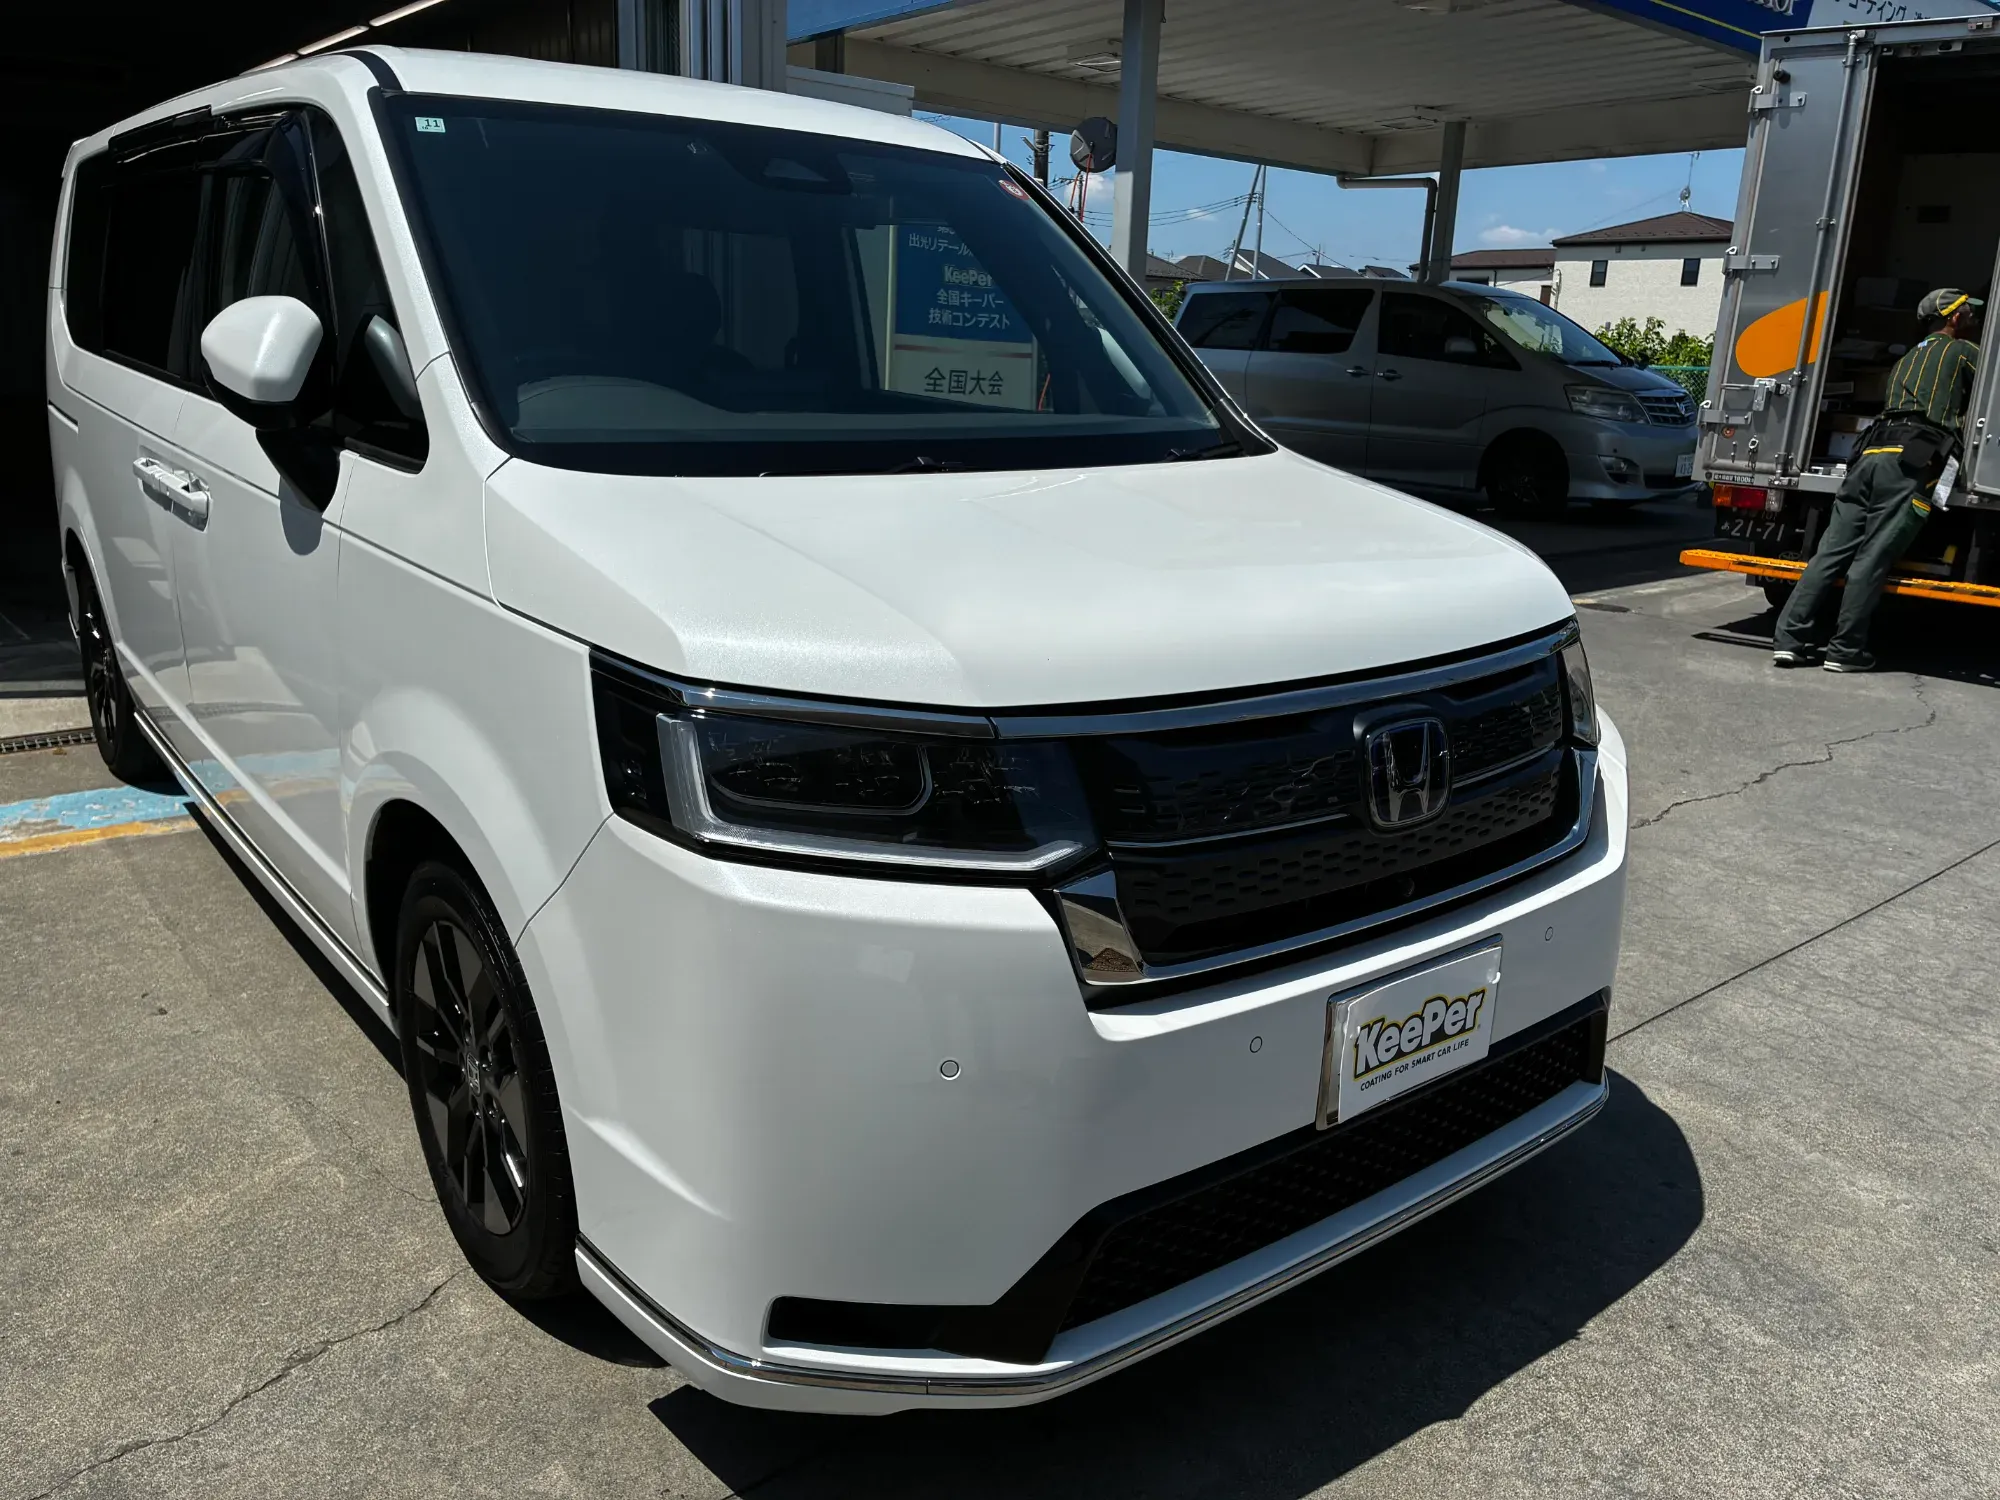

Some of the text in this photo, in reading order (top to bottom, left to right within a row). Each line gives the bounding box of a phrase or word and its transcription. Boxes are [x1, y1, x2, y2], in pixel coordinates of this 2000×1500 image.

[423, 119, 440, 128] 11
[908, 232, 974, 257] 出光リテール
[944, 264, 993, 288] KeePer
[936, 288, 1004, 308] 全国キーパー
[928, 307, 1010, 330] 技術コンテスト
[924, 366, 1003, 396] 全国大会
[1731, 519, 1785, 541] 21-71
[1354, 988, 1486, 1080] KeePer
[1360, 1038, 1470, 1091] COATING FOR SMART CAR LIFE
